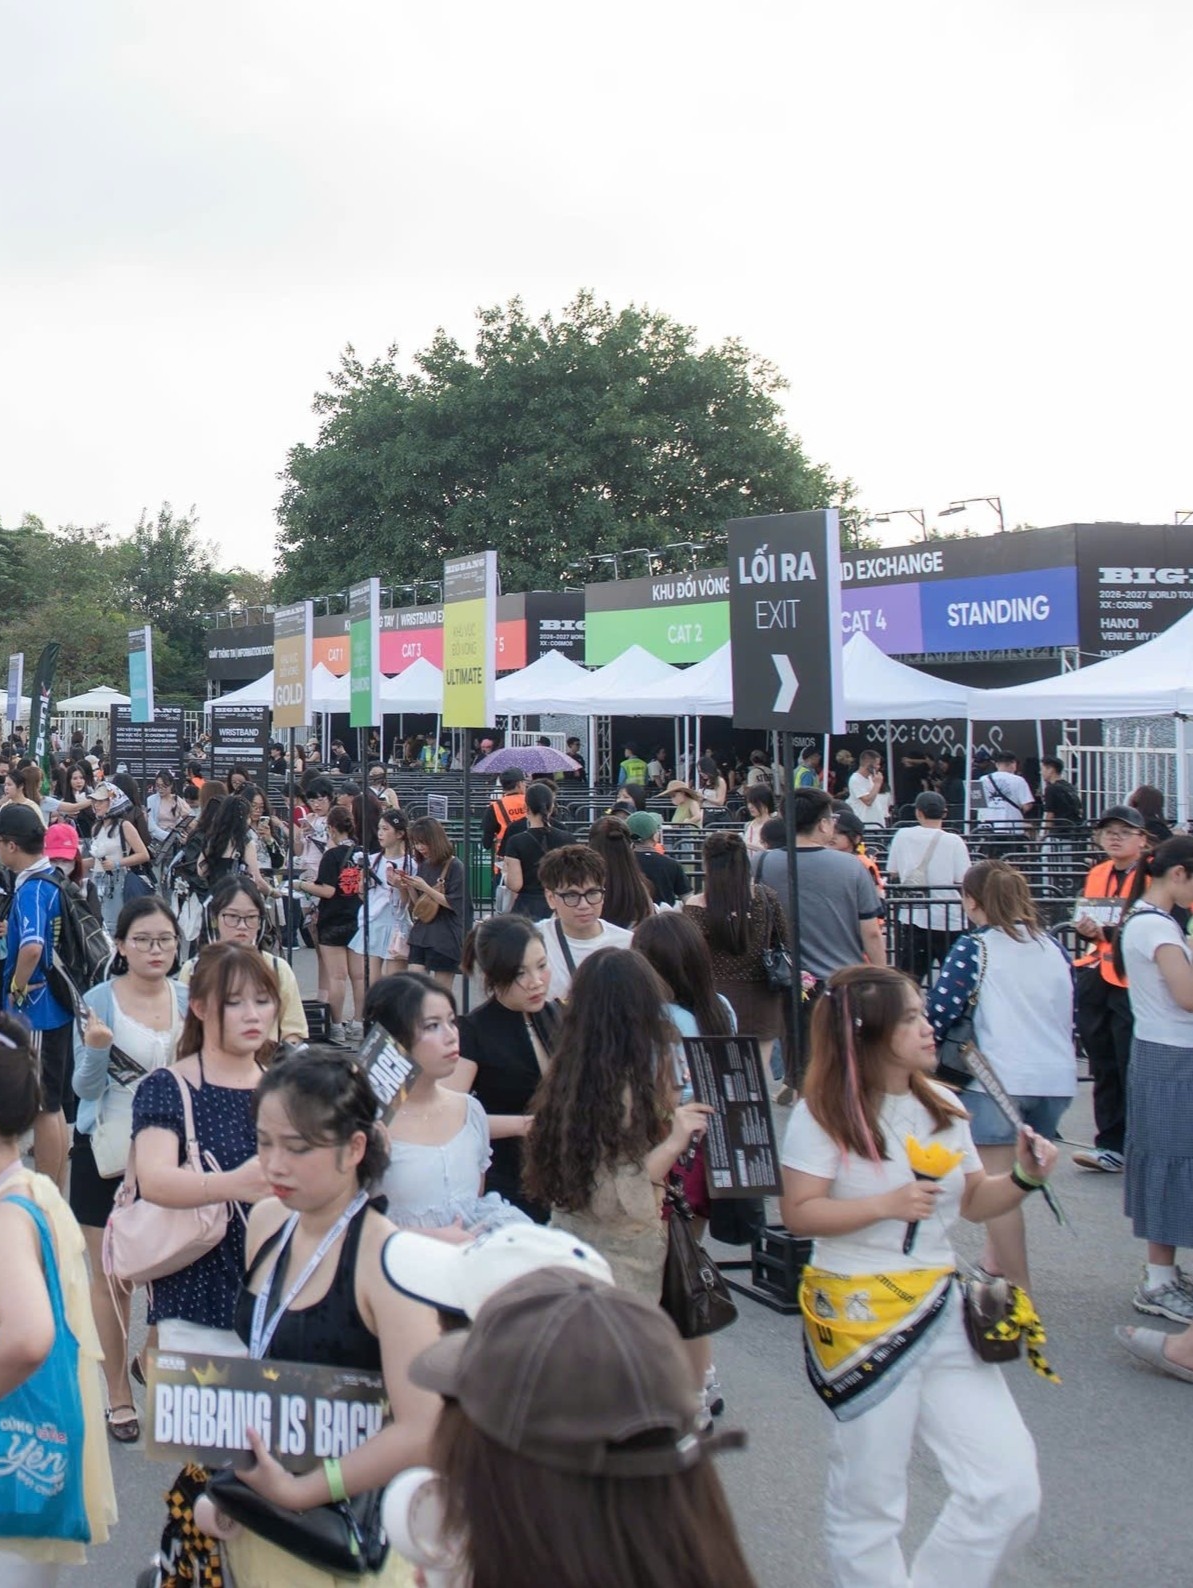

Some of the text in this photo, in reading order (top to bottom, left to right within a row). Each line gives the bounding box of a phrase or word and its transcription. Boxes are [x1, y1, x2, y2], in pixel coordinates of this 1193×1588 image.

[738, 543, 775, 585] LỐI
[780, 551, 817, 582] RA
[858, 551, 944, 580] EXCHANGE
[1098, 567, 1193, 584] BIG
[652, 583, 675, 601] KHU
[700, 574, 730, 597] VÒNG
[1148, 590, 1177, 599] WORLD
[383, 615, 394, 628] TAY
[400, 611, 437, 626] WRISTBAND
[755, 599, 801, 629] EXIT
[841, 608, 887, 633] CAT 4
[947, 595, 1050, 627] STANDING
[539, 620, 585, 631] BIG
[1100, 618, 1139, 629] HANOI
[667, 624, 703, 645] CAT 2
[401, 642, 422, 658] CAT 3
[498, 637, 505, 652] 5
[328, 648, 340, 661] CAT
[446, 667, 482, 686] ULTIMATE
[275, 683, 303, 706] GOLD
[218, 728, 259, 737] WRISTBAND
[154, 1383, 272, 1453] BIGBANG
[279, 1393, 307, 1456] IS
